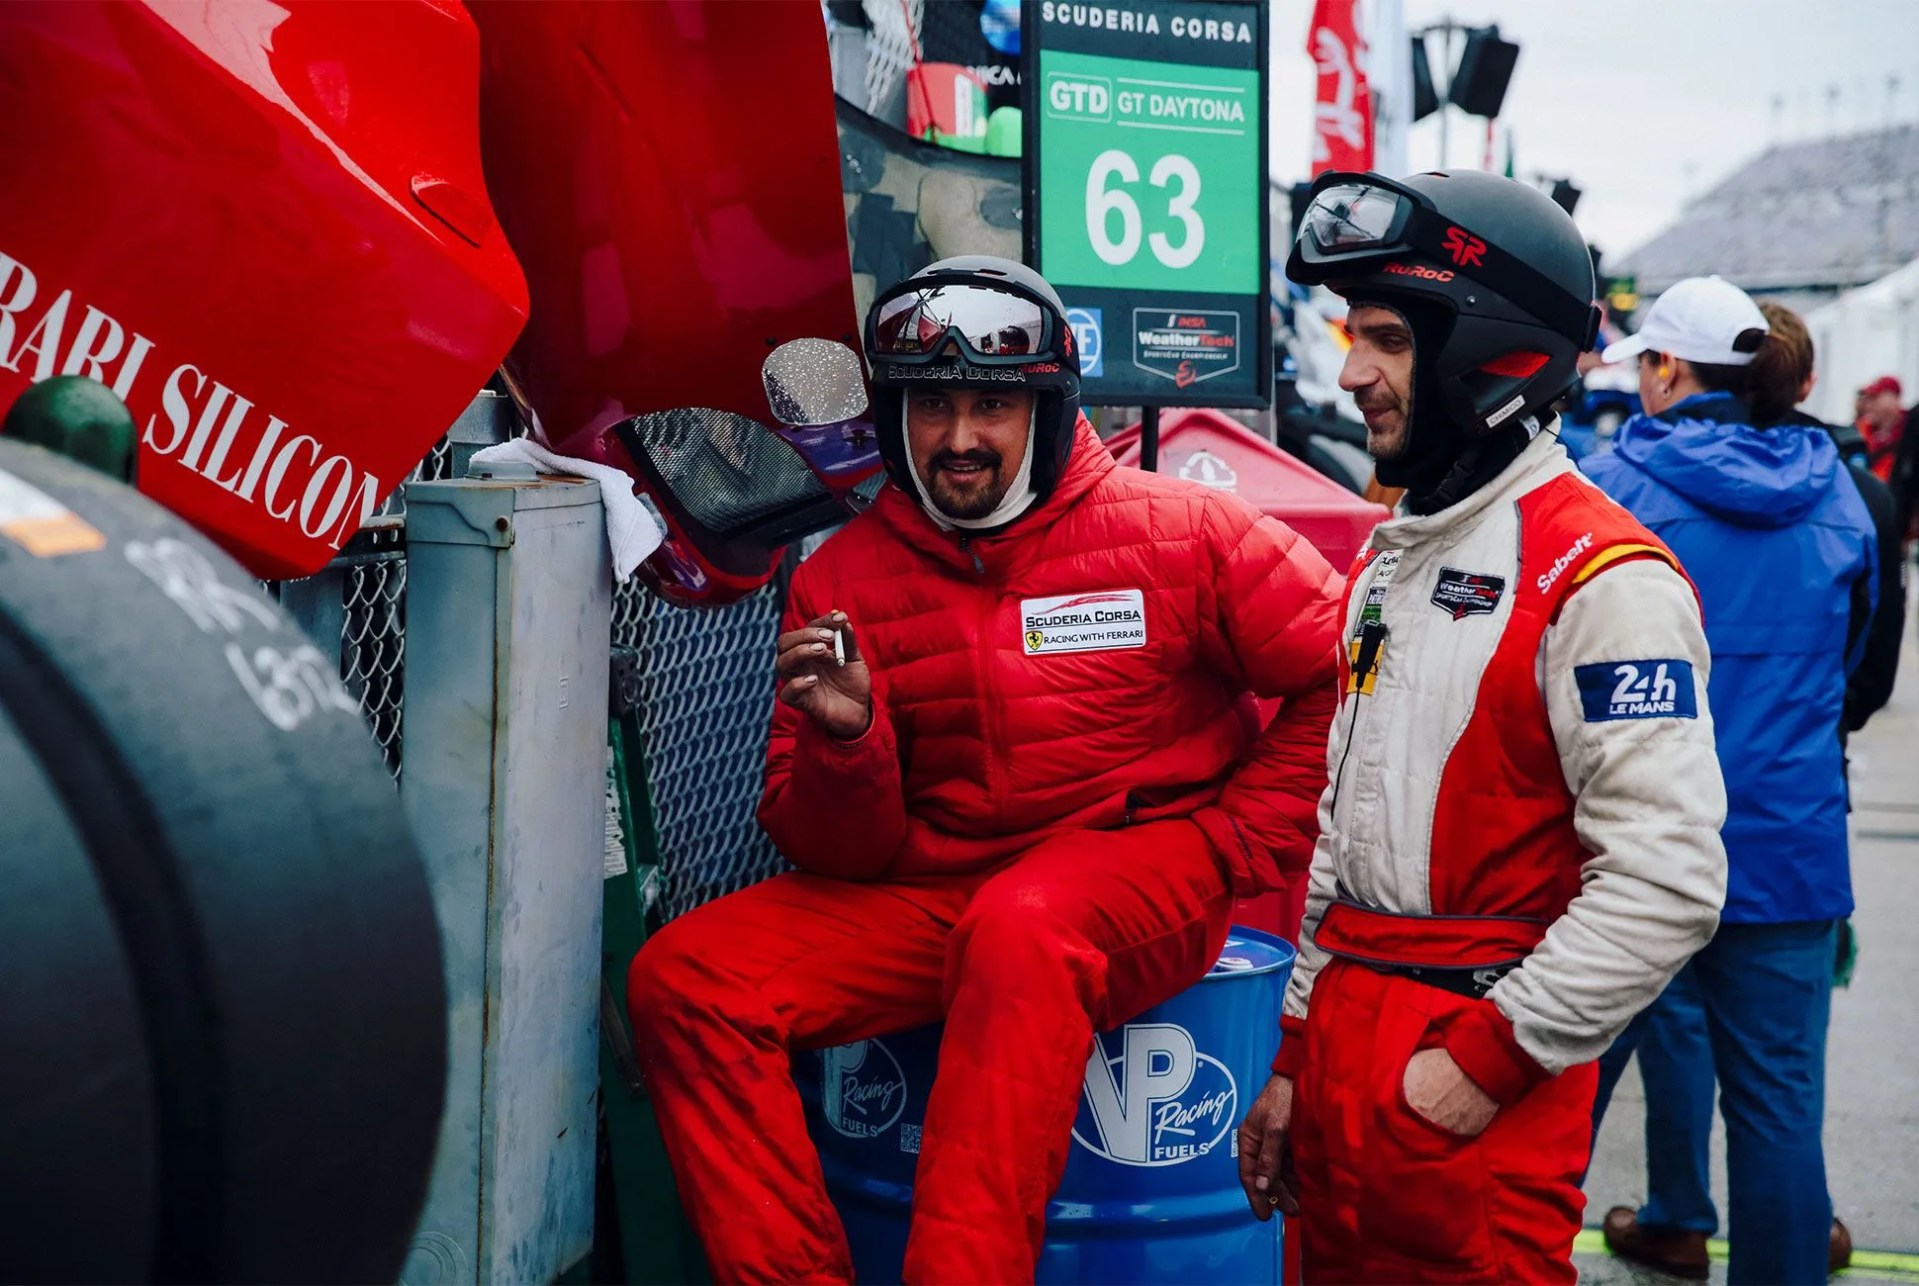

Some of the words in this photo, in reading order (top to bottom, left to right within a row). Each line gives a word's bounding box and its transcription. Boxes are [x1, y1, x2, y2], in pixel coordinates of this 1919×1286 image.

[1042, 2, 1160, 35] SCUDERIA
[1170, 16, 1252, 43] CORSA
[1049, 80, 1109, 114] GTD
[1117, 92, 1145, 115] GT
[1150, 95, 1245, 123] DAYTONA
[1086, 149, 1205, 269] 63
[888, 364, 962, 380] SCUDERIA
[966, 365, 1026, 382] CORSA
[142, 363, 380, 551] SILICON
[1537, 532, 1592, 595] Sabelt
[1026, 613, 1092, 628] SCUDERIA
[1095, 610, 1141, 622] CORSA
[1044, 633, 1079, 644] RACING
[1079, 632, 1104, 642] WITH
[1106, 630, 1143, 640] FERRARI
[1611, 663, 1676, 704] 24h
[1609, 703, 1626, 715] LE
[1629, 701, 1674, 714] MANS
[843, 1075, 903, 1115] Racing
[842, 1117, 879, 1137] FUELS
[1155, 1090, 1234, 1145] Racing
[1155, 1142, 1210, 1159] FUELS
